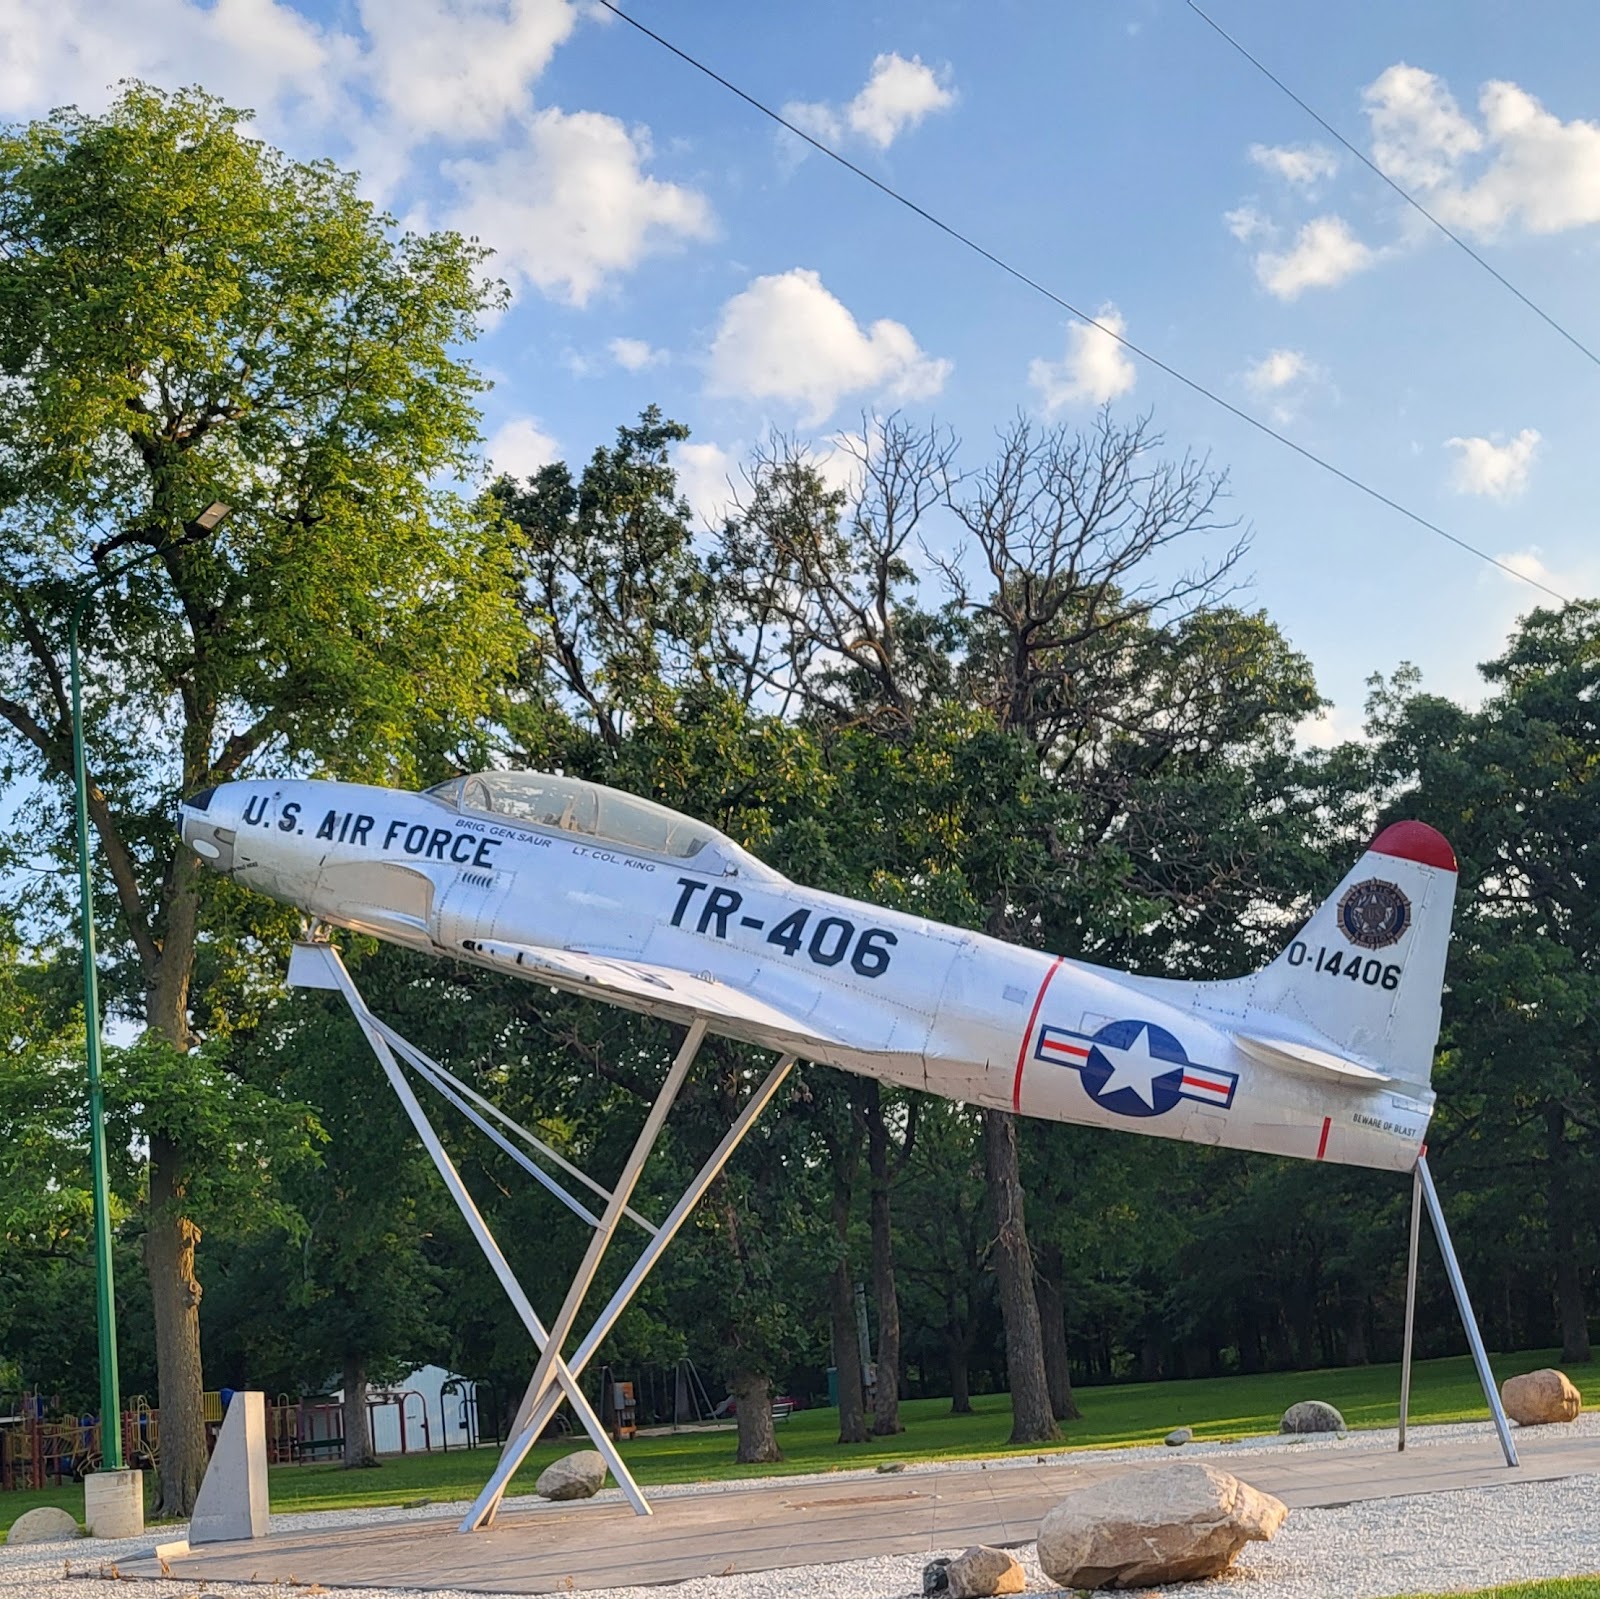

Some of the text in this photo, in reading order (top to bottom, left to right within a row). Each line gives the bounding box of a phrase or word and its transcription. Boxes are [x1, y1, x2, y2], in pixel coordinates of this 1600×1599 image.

[243, 795, 502, 869] U.S. AIR FORCE
[516, 833, 552, 848] SAUR
[572, 846, 656, 873] LT. COL. KING
[670, 877, 899, 978] TR-406
[1353, 1113, 1417, 1137] BEWARE OF BLAST
